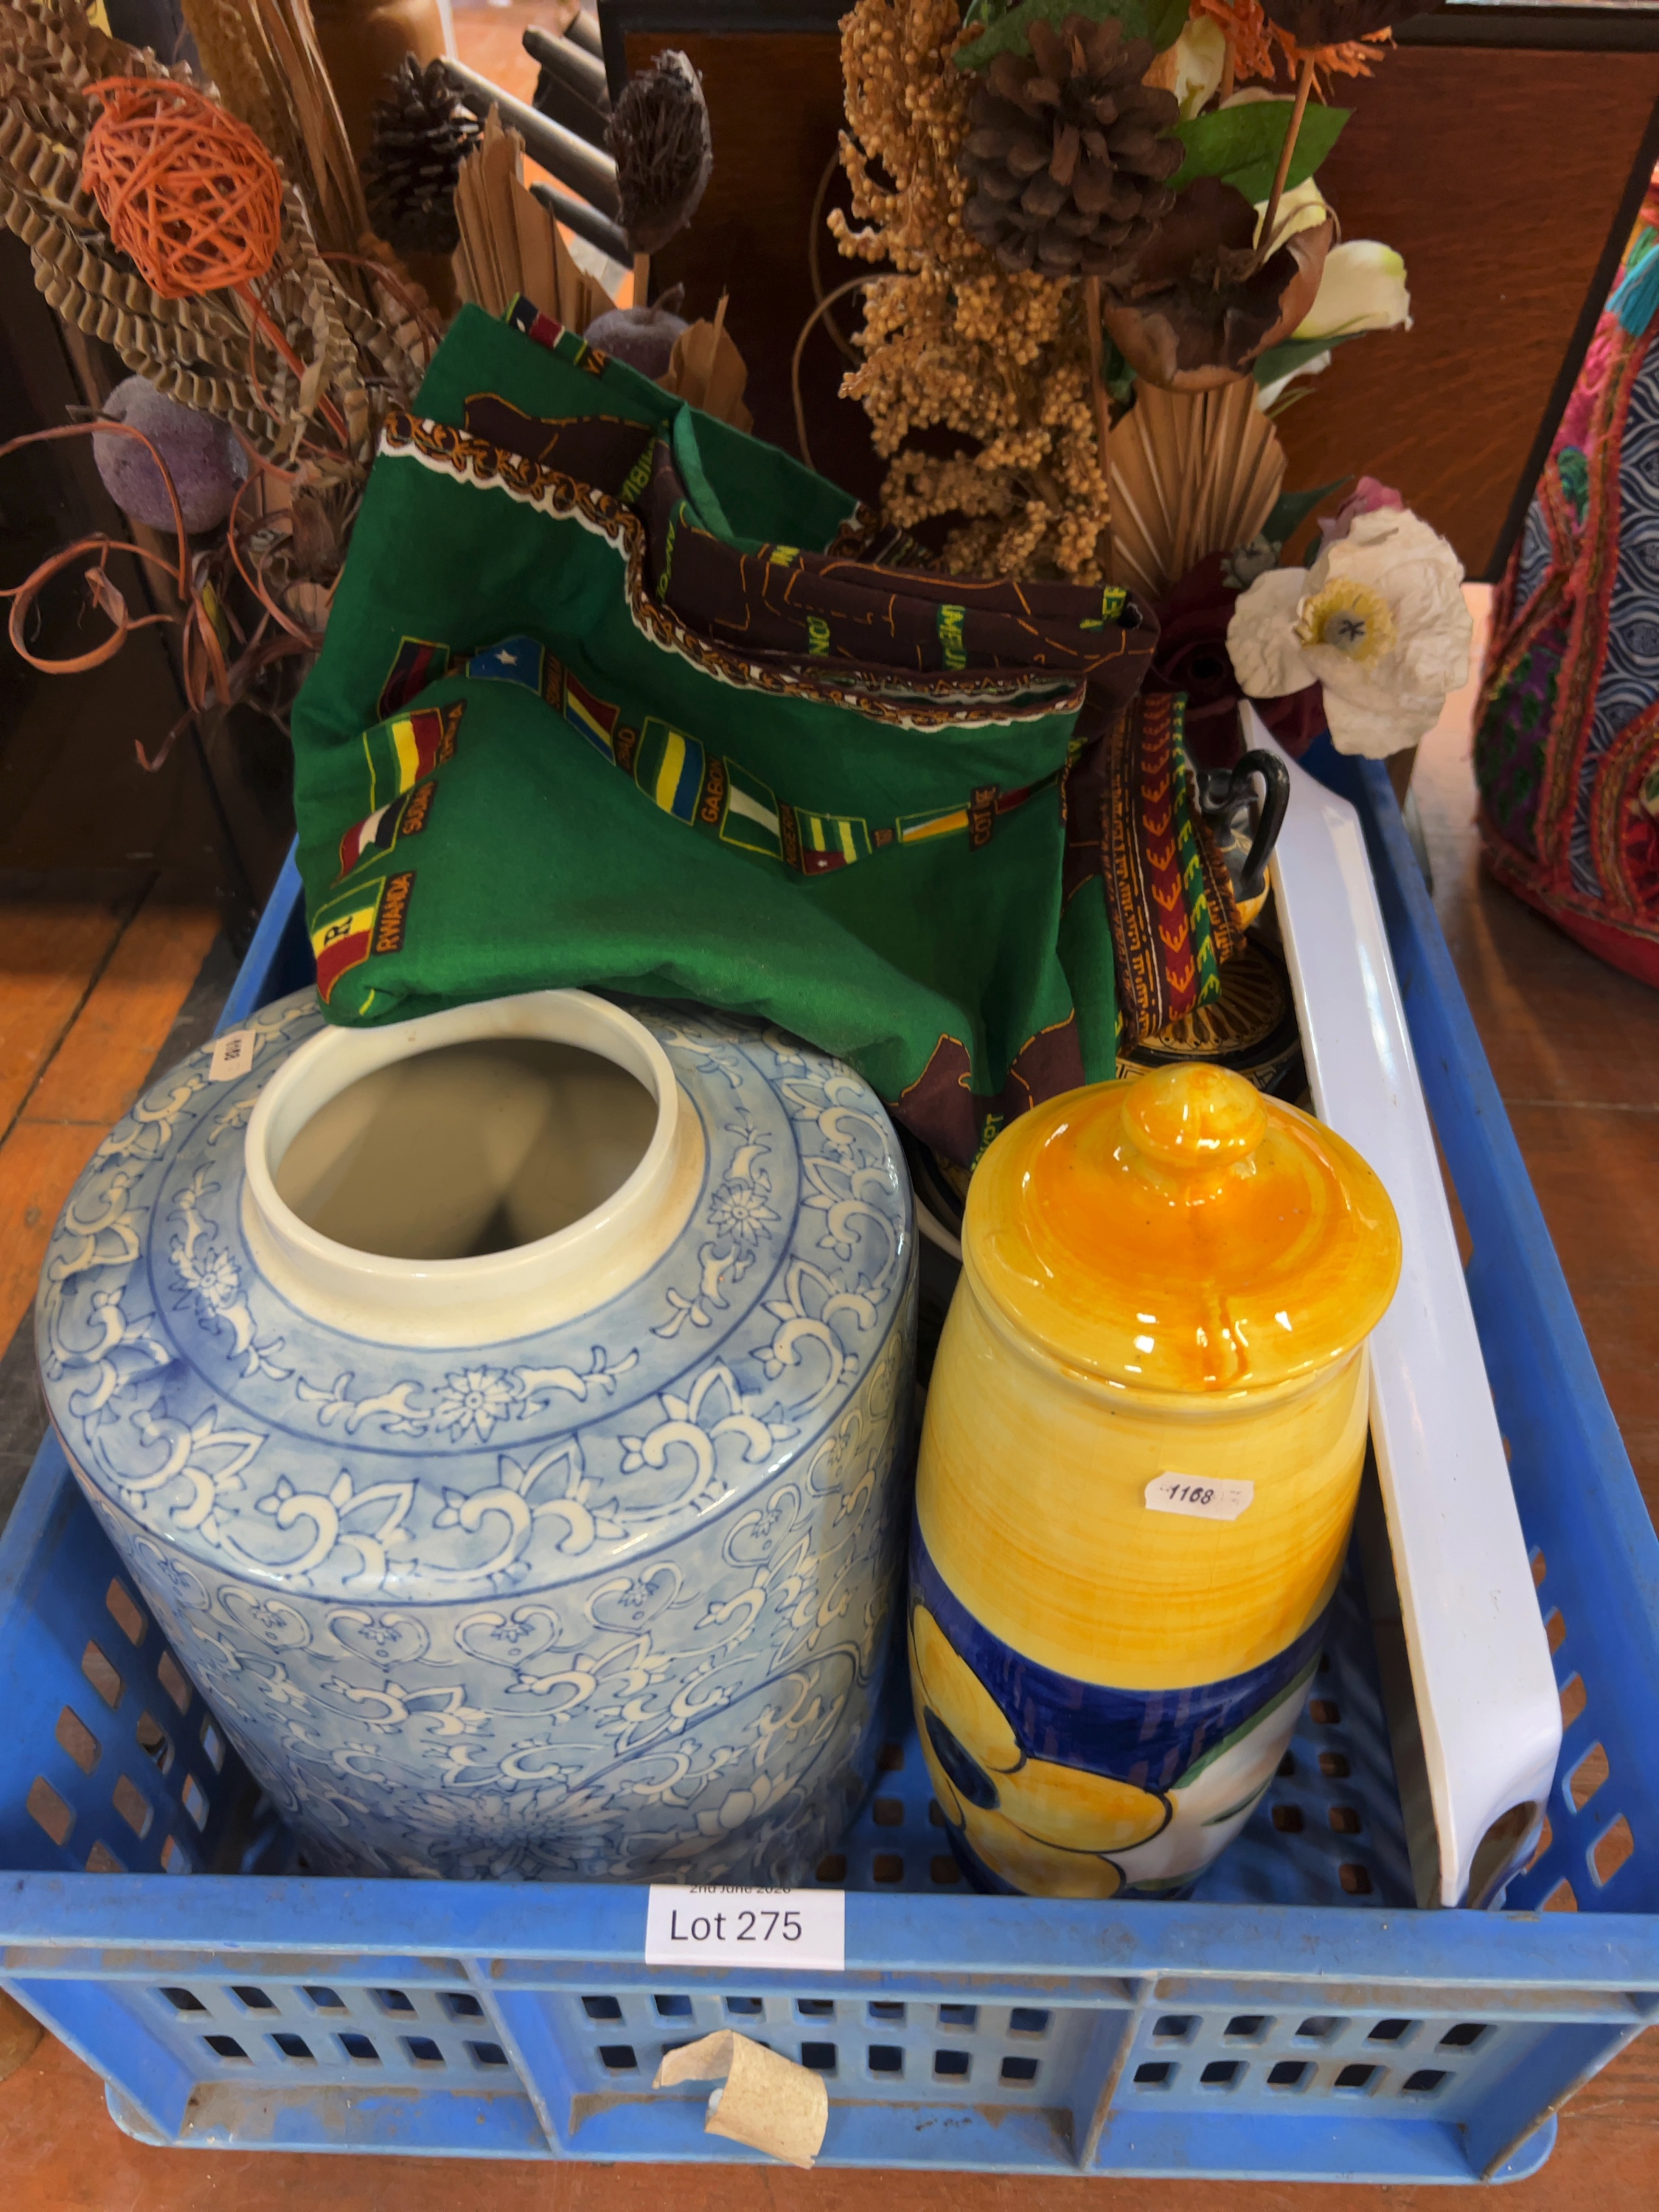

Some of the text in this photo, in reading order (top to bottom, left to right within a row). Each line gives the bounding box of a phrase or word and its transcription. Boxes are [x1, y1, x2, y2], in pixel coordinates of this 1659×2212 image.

[701, 757, 724, 824] GABON
[375, 872, 414, 953] RWANDA
[324, 915, 354, 947] R
[1168, 1484, 1215, 1506] 1168
[670, 1909, 803, 1942] Lot 275
